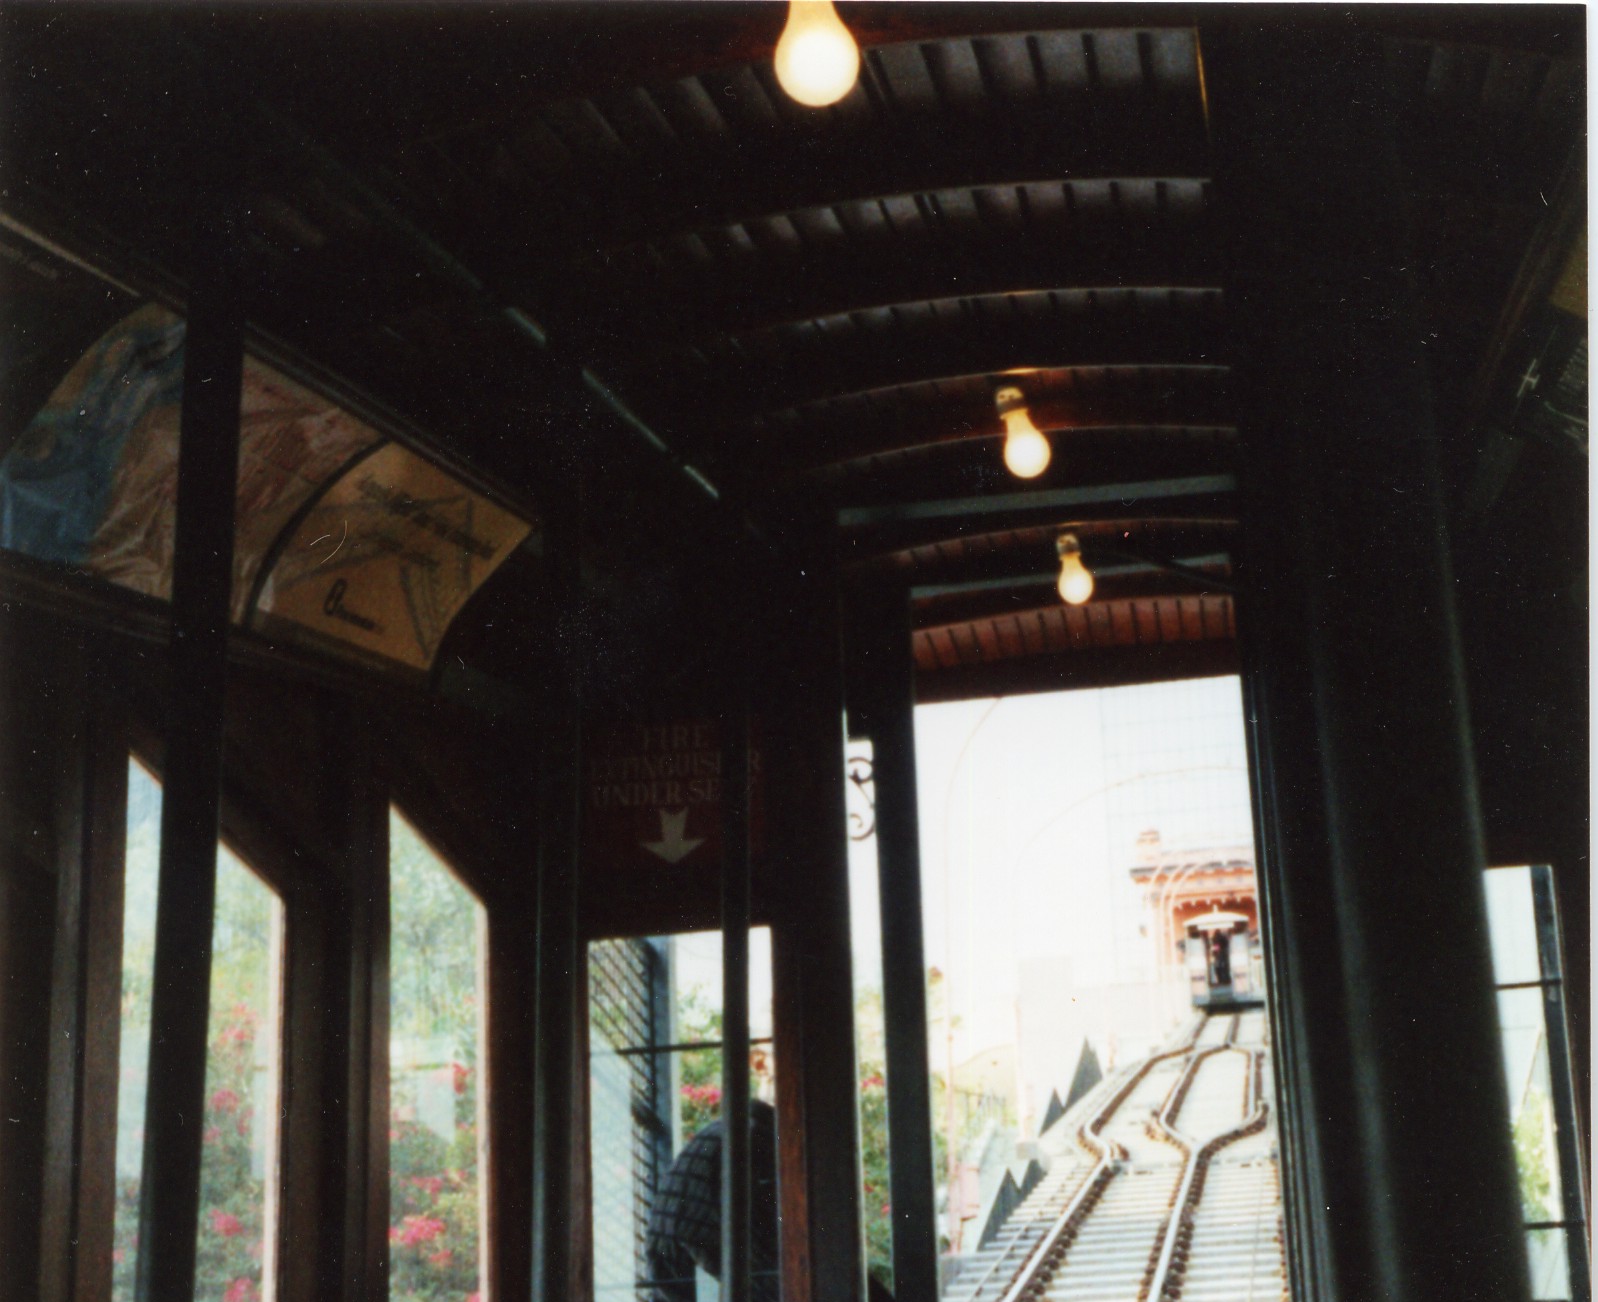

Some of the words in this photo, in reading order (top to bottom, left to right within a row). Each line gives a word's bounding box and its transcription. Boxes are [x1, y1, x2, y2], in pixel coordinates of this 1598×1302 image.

[641, 721, 710, 750] FIRE
[590, 745, 761, 781] EXTINGUISR
[592, 780, 682, 809] UNDER
